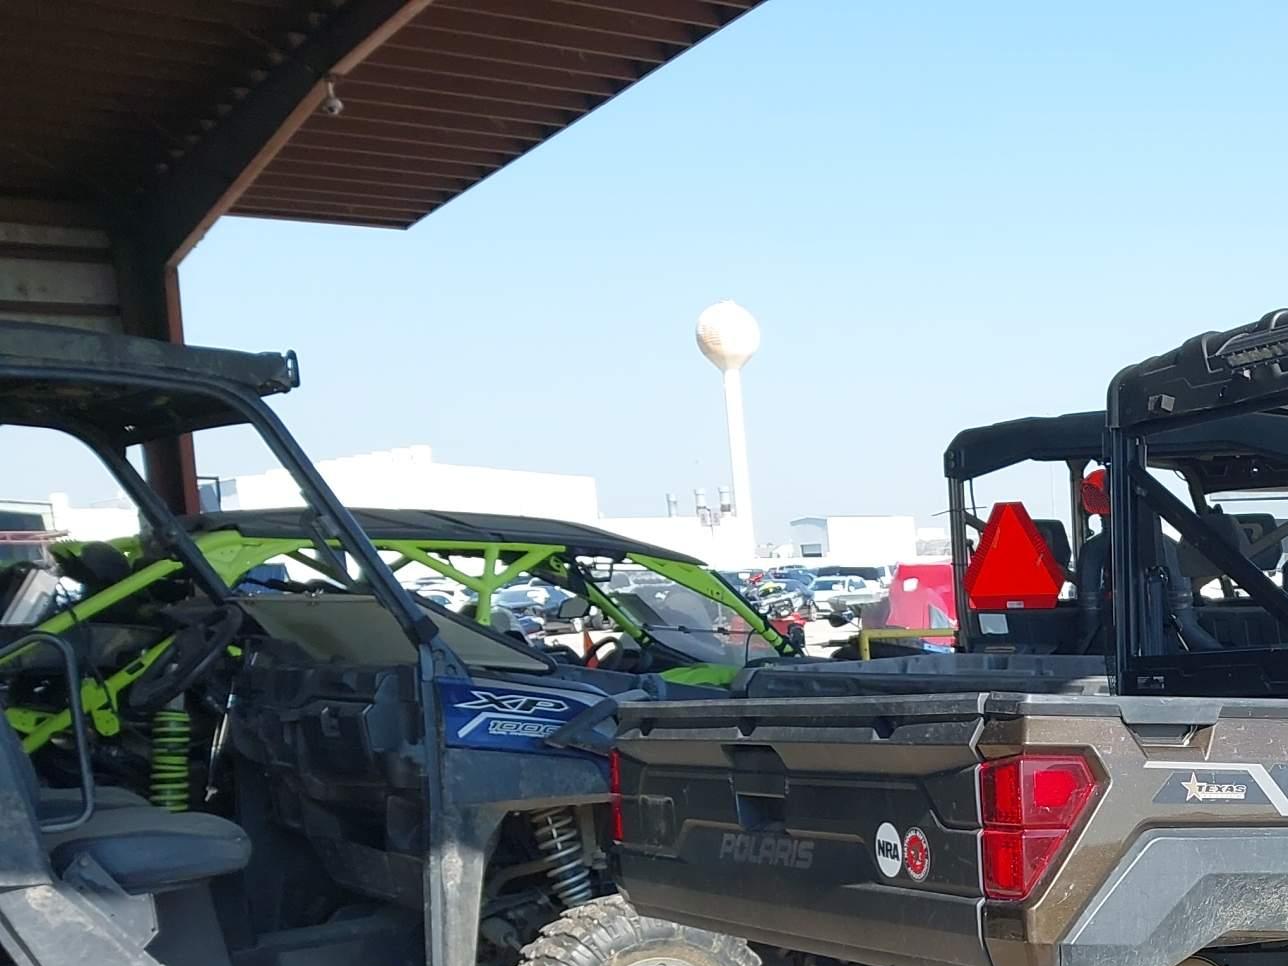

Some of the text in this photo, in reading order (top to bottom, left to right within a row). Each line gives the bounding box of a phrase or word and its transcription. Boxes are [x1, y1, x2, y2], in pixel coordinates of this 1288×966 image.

[453, 690, 570, 714] XP
[1196, 785, 1245, 793] TEXAS
[719, 832, 816, 870] POLARIS
[877, 839, 900, 861] NRA
